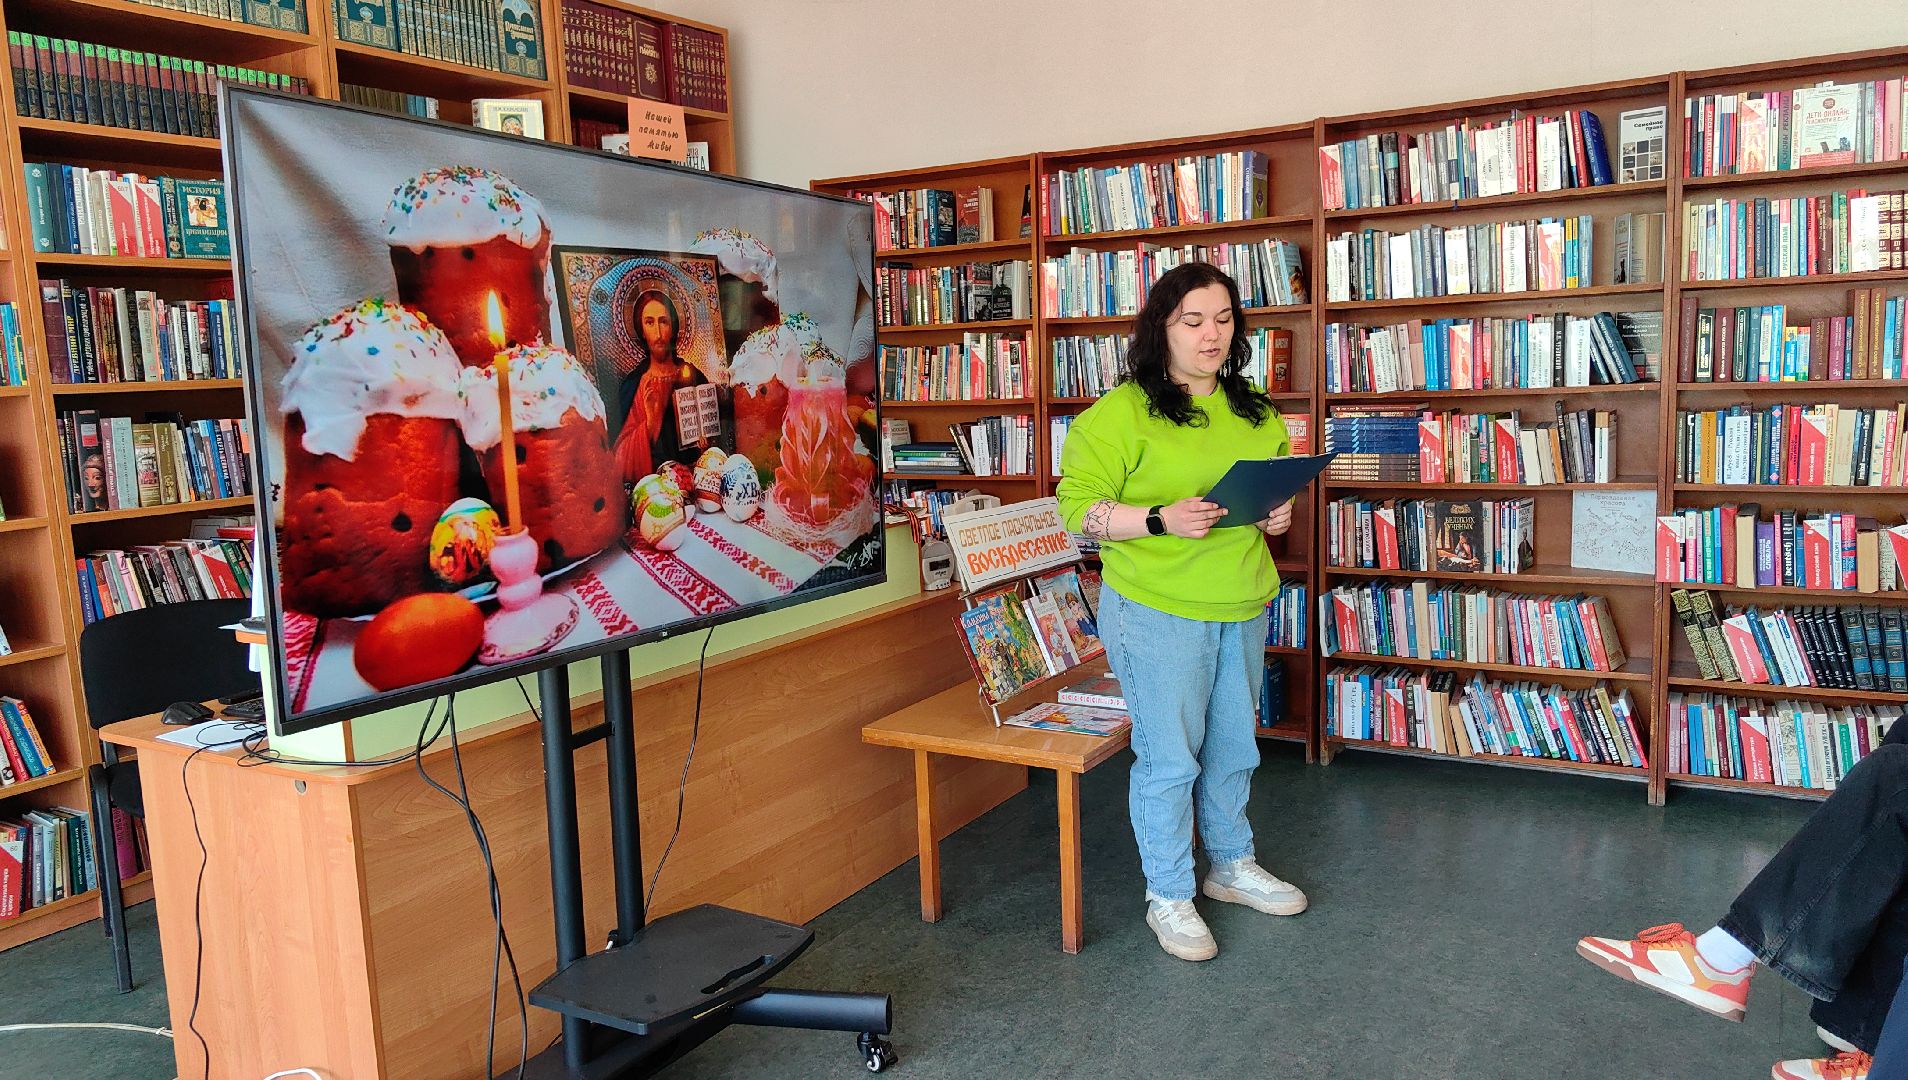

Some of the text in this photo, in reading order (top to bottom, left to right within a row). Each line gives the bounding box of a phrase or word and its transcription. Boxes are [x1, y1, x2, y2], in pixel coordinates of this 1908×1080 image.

[639, 126, 679, 139] памятью
[645, 110, 672, 124] Нашей
[1780, 96, 1789, 164] ОСНОВЫ РЕКЛАМЫ
[647, 139, 671, 152] живы
[182, 186, 221, 195] ИСТОРИЯ
[67, 315, 80, 374] ДРЕВНИЙ МИР
[959, 511, 1057, 547] СВЕТЛОЕ ПАСХАЛЬНОЕ
[1445, 516, 1475, 524] ВЕЛИКИХ
[967, 531, 1071, 575] ВОСКРЕСЕНИЕ
[1784, 542, 1794, 576] deutsch
[1546, 615, 1557, 656] АВТОМЕХАНИК
